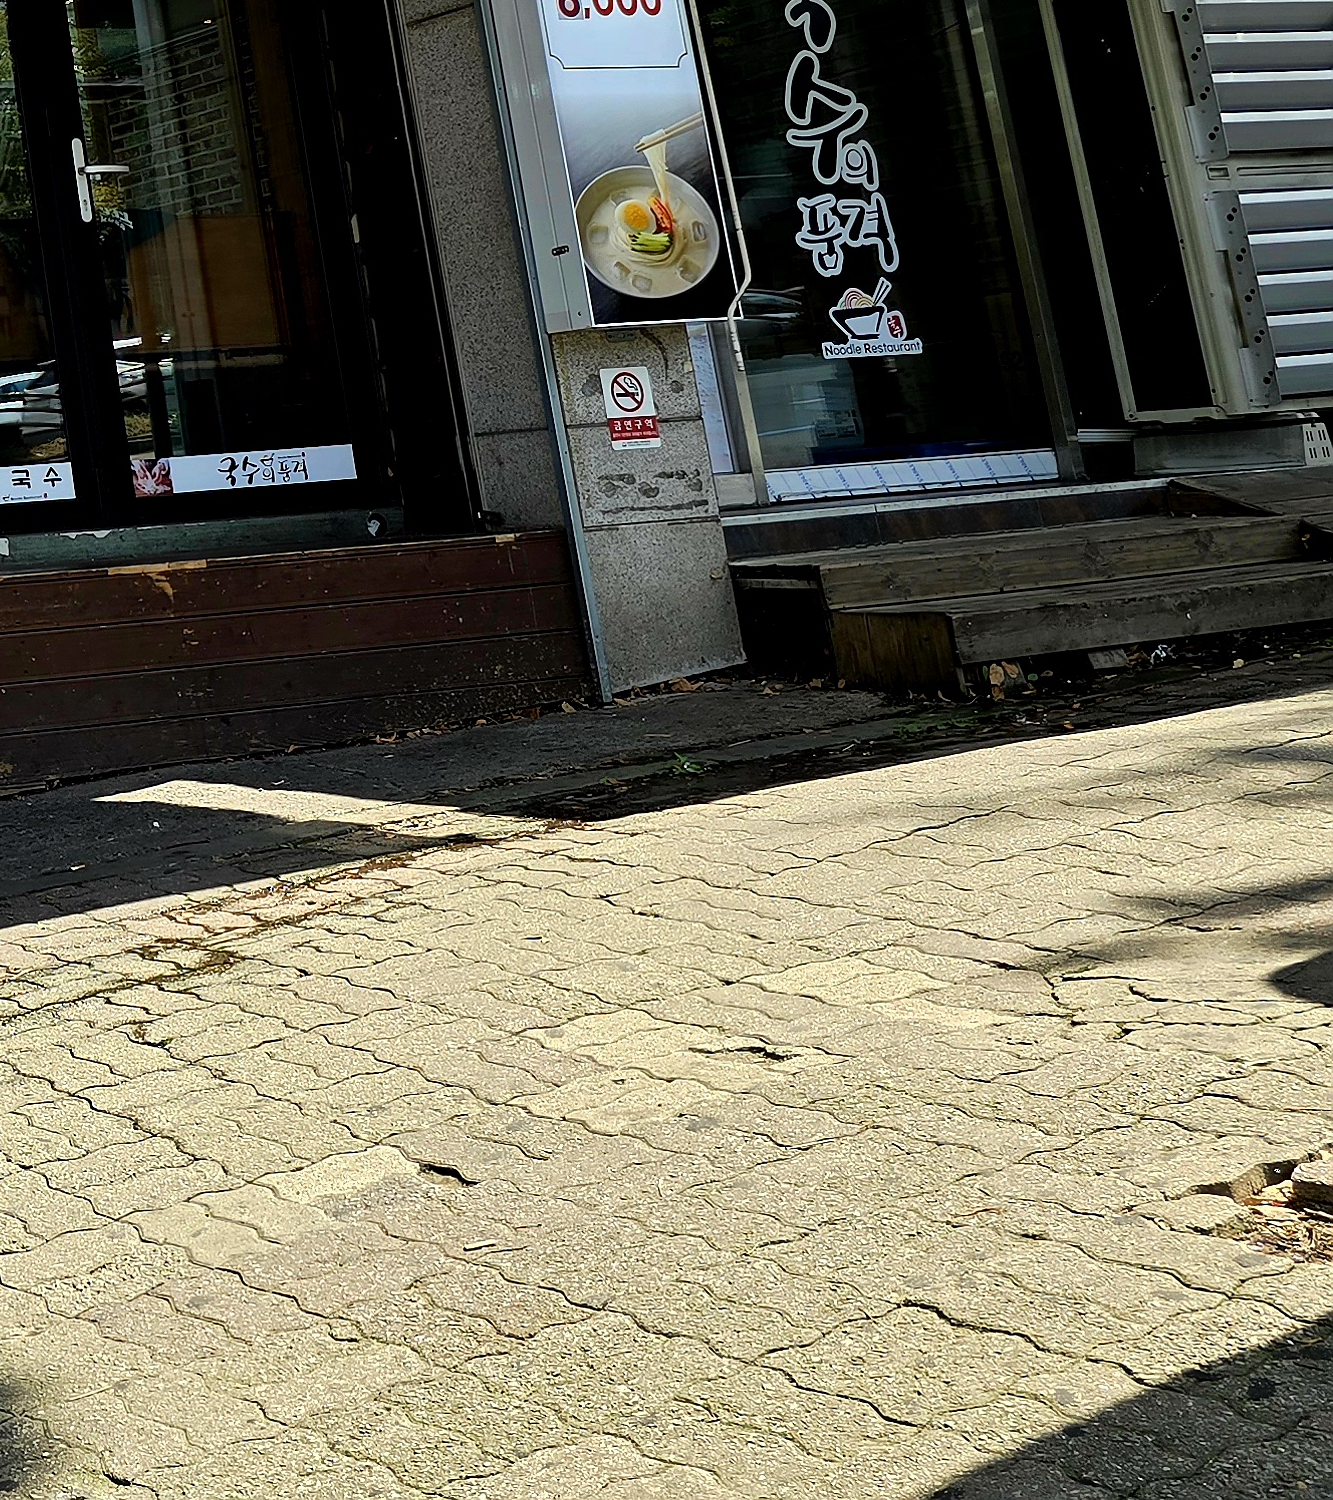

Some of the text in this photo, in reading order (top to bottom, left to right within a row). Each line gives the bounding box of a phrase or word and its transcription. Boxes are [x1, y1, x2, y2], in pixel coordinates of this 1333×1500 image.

[823, 340, 921, 357] Noodle Restaurant
[613, 418, 654, 431] 금연구역
